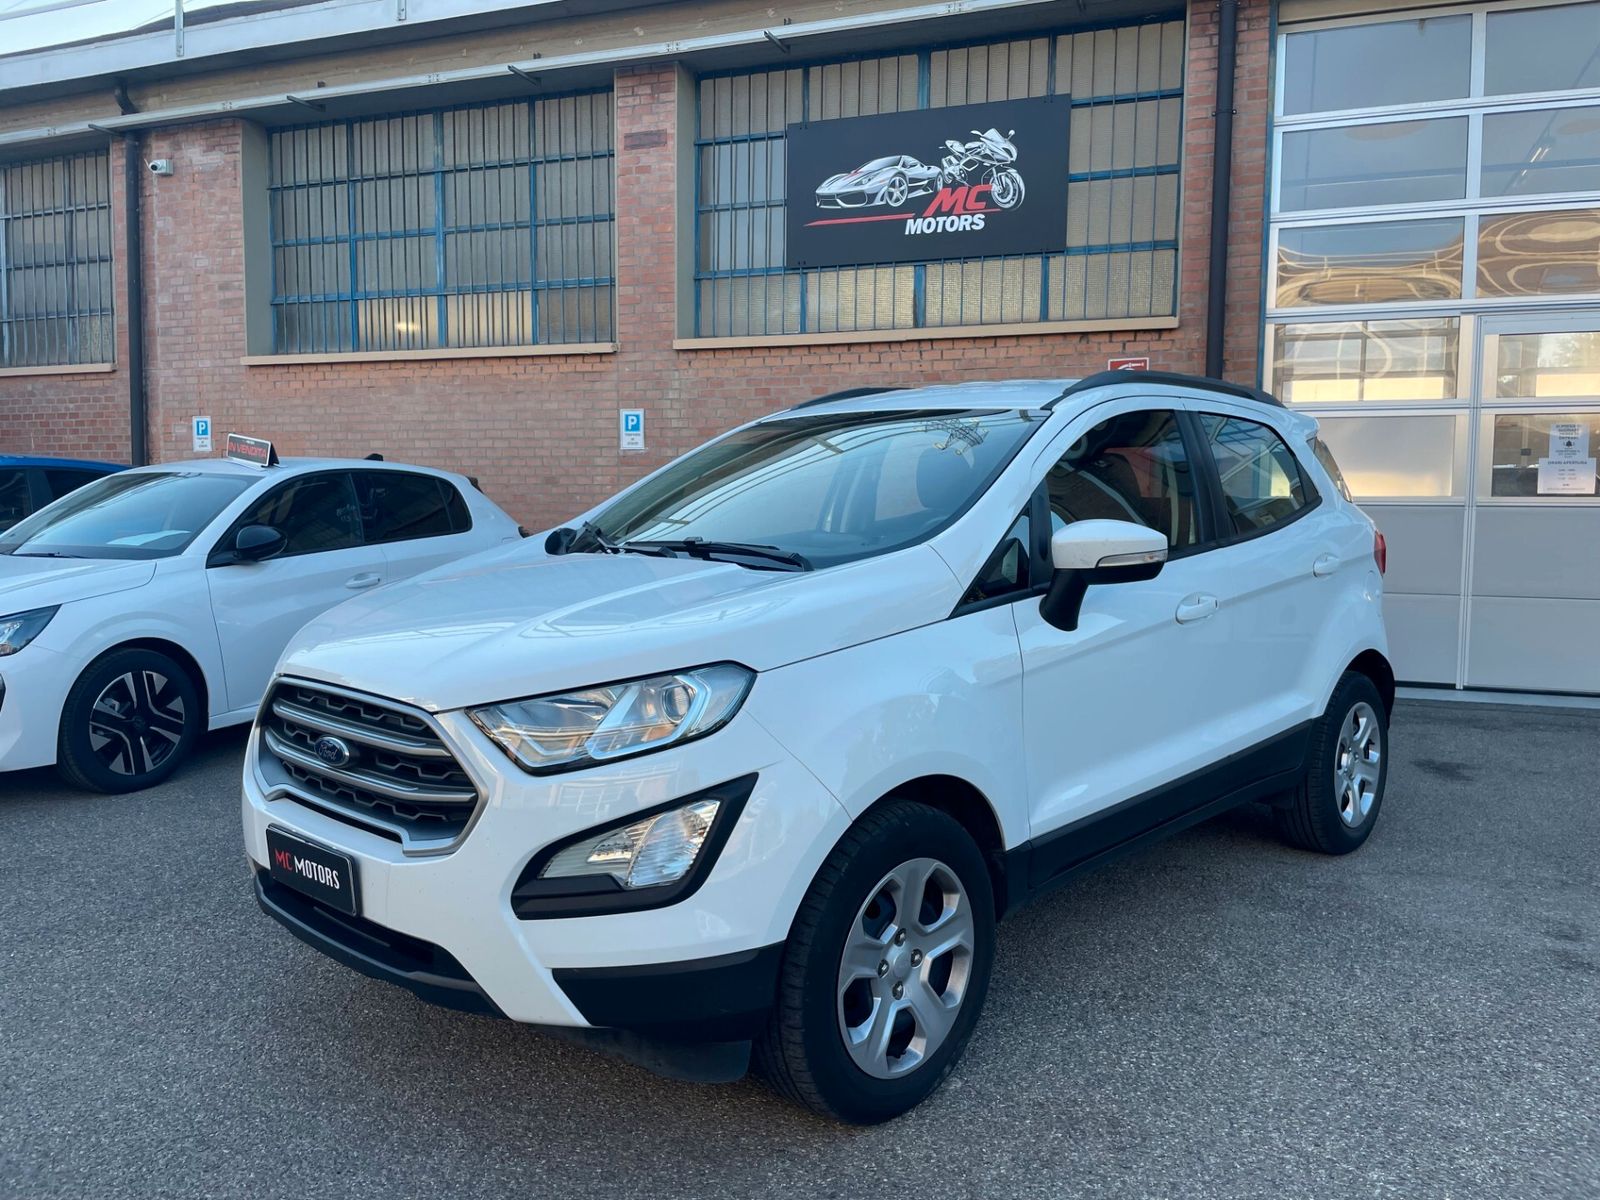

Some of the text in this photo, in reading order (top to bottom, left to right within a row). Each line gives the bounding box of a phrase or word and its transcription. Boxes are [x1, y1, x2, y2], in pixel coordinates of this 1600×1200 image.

[922, 184, 993, 217] MC
[905, 213, 986, 235] MOTORS
[198, 421, 206, 435] P
[627, 415, 638, 430] P
[274, 848, 340, 890] MC MOTORS
